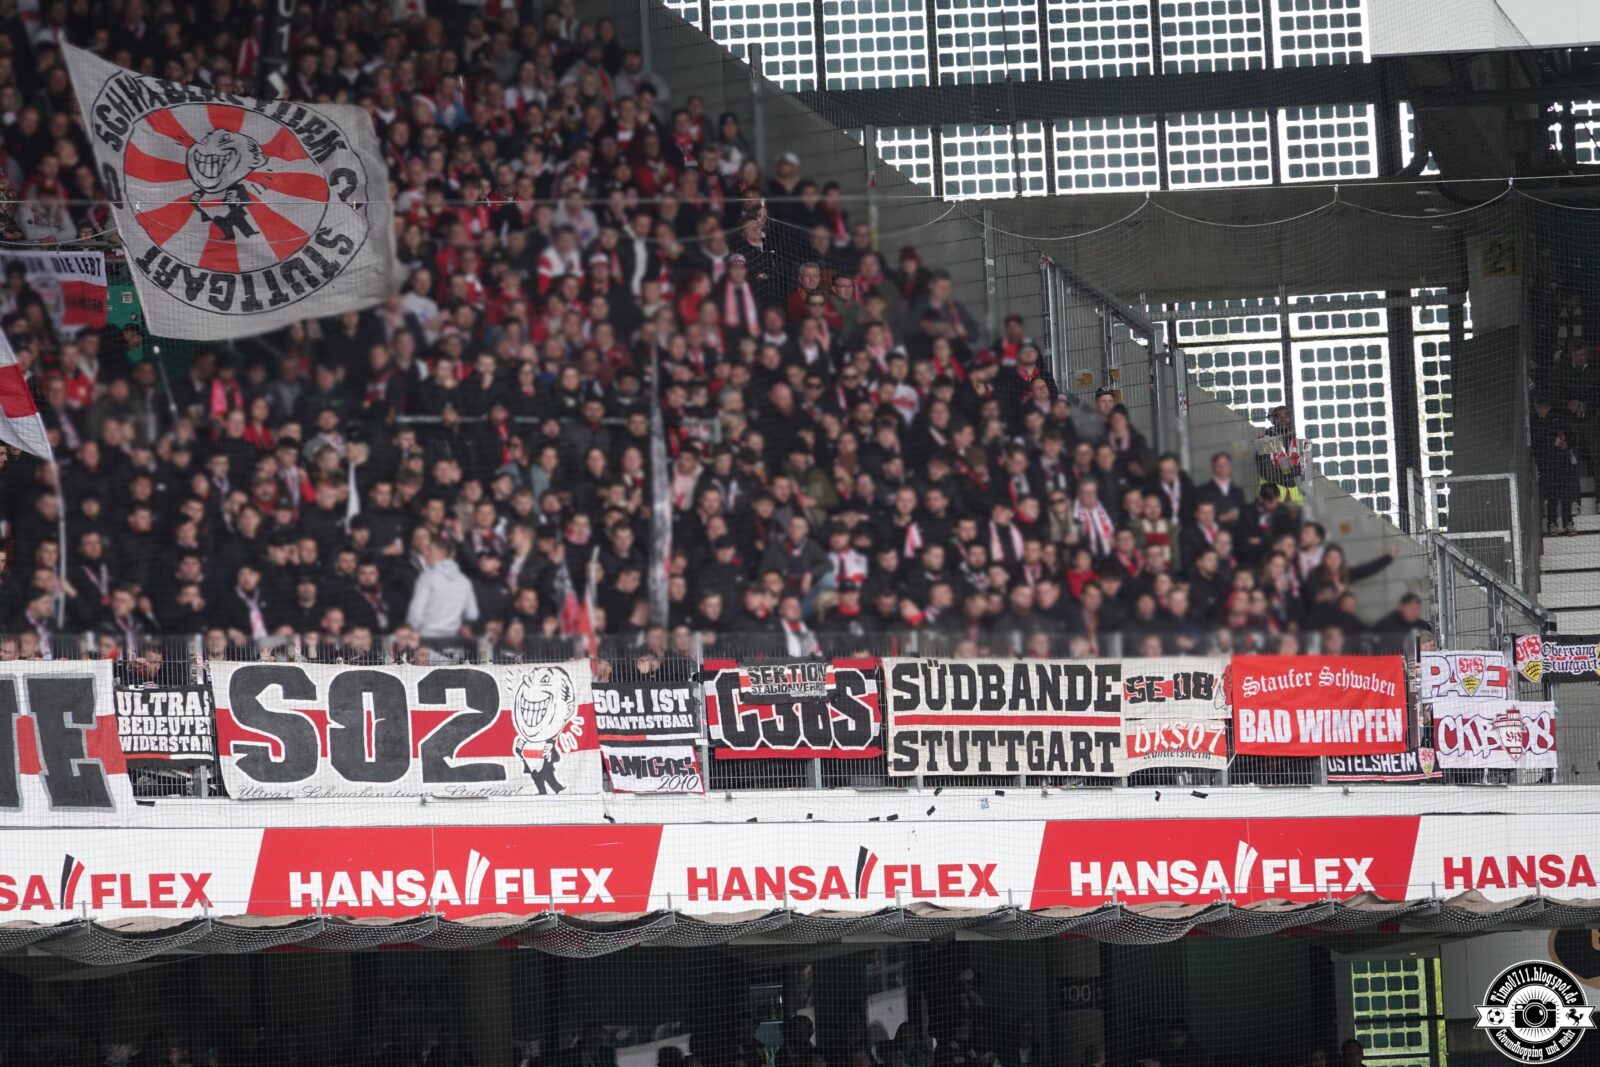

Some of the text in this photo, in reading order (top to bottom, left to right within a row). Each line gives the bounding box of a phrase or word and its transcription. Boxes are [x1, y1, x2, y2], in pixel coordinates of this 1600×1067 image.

[136, 226, 354, 313] STUTTGART
[1541, 642, 1597, 658] Oberrang
[1542, 658, 1598, 675] Stuttgart
[747, 663, 827, 684] SEKTION
[892, 659, 1122, 712] SÜDBANDE
[1242, 666, 1396, 698] Staufer Schwaben
[116, 691, 210, 716] ULTRAS
[592, 689, 689, 714] 50+1 IST
[1239, 708, 1403, 743] BAD WIMPFEN
[893, 731, 1121, 772] STUTTGART
[657, 775, 699, 791] 2010
[289, 868, 615, 907] HANSA FLEX
[687, 863, 1000, 901] HANSA FLEX
[1070, 857, 1376, 896] HANSA FLEX
[1443, 854, 1597, 889] HANSA
[91, 873, 213, 909] FLEX
